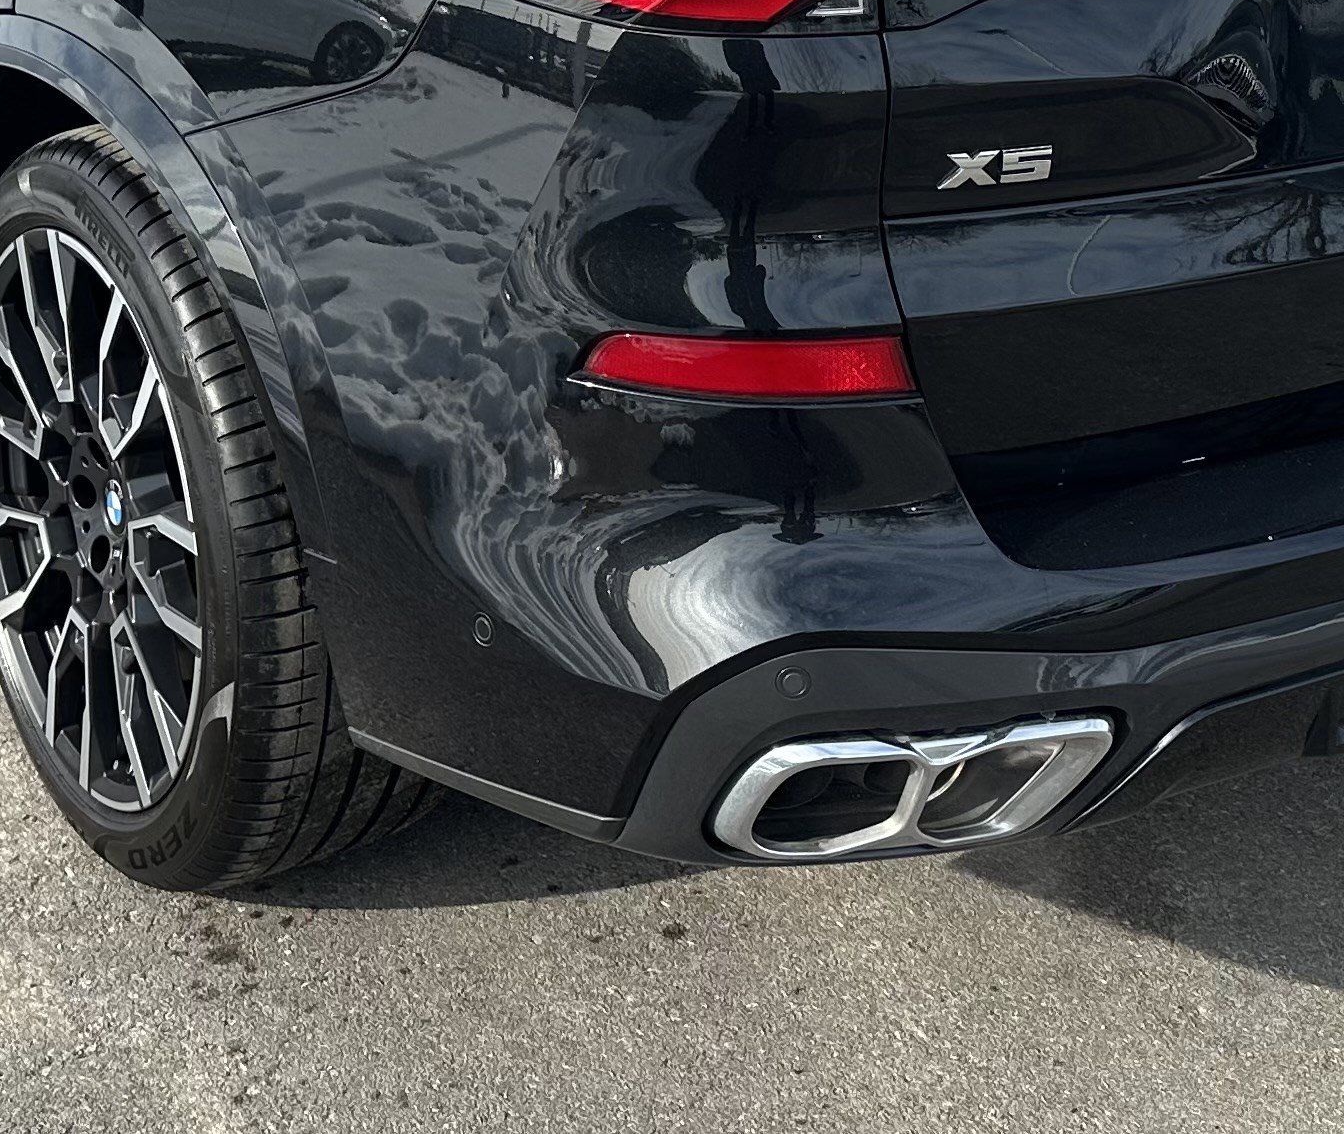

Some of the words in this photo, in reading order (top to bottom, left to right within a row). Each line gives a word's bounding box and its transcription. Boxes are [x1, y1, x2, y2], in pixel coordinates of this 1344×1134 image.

[937, 144, 1052, 189] X5
[75, 191, 135, 279] PIRELLI
[127, 800, 198, 869] ZERO
